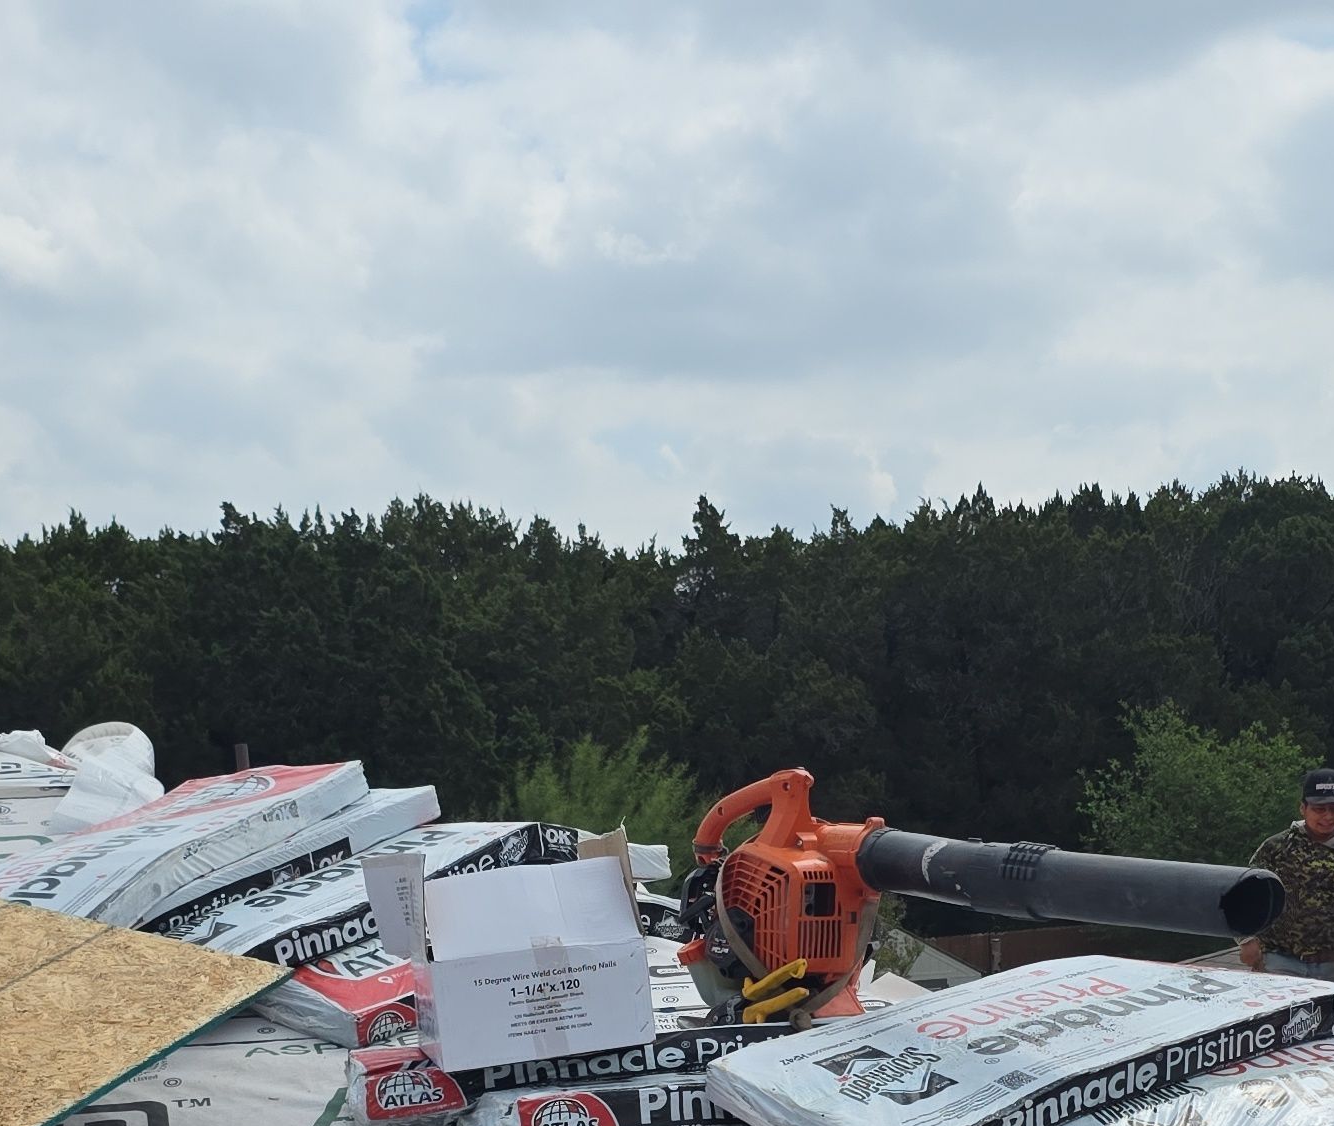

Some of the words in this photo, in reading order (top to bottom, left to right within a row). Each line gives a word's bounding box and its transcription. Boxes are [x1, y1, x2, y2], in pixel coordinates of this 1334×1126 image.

[544, 827, 572, 846] OK
[474, 979, 483, 987] 15
[485, 976, 511, 986] Degree
[512, 973, 530, 982] Wire
[531, 969, 551, 979] Weld
[552, 967, 567, 976] Coil
[568, 964, 597, 975] Roofing
[598, 960, 617, 969] Nails
[917, 976, 1131, 1040] Pristine
[967, 974, 1240, 1056] Pinnacle
[484, 1044, 686, 1089] Pinnacle
[1166, 1022, 1276, 1080] Pristine
[839, 1046, 943, 1104] Scotchgard
[172, 1097, 213, 1109] TM
[383, 1087, 444, 1109] ATLAS
